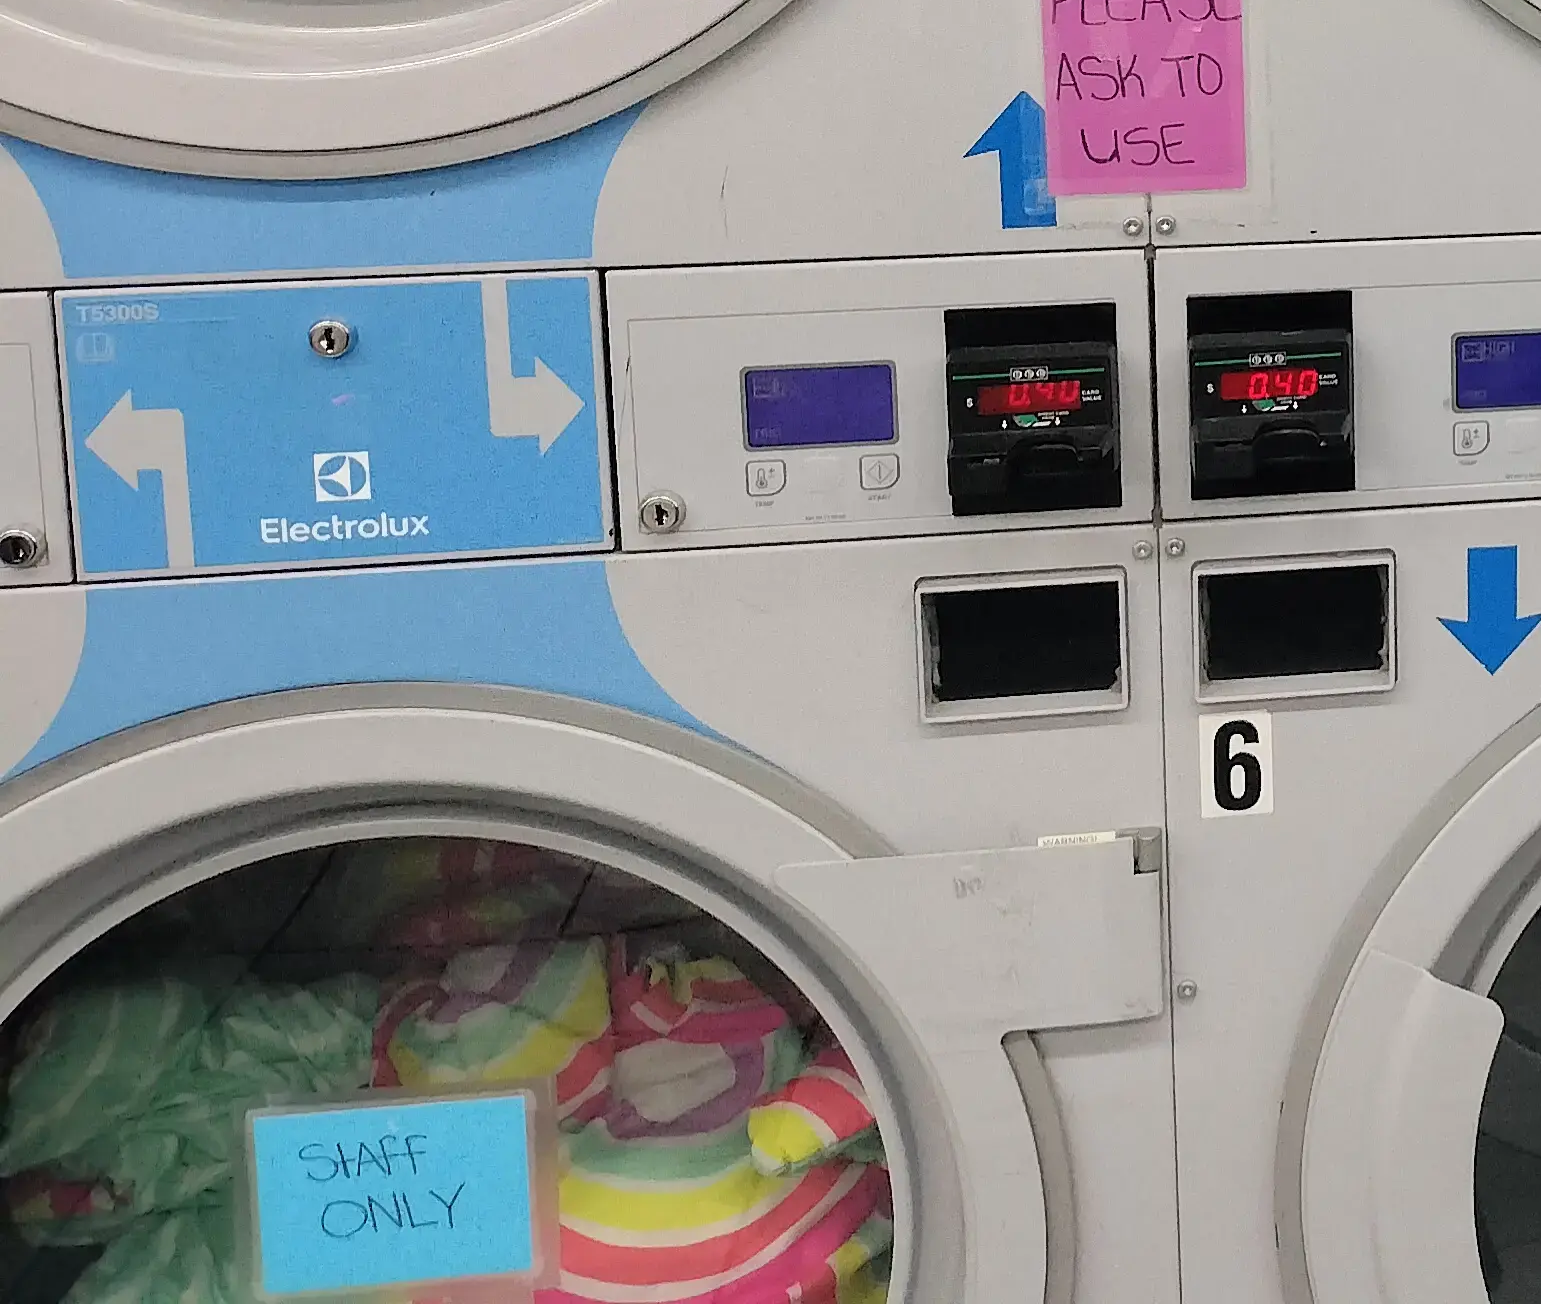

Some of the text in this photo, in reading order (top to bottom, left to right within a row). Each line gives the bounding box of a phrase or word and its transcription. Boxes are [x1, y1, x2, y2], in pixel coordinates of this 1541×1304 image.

[1056, 52, 1223, 101] ASK TO
[1080, 123, 1195, 166] USE
[76, 302, 160, 323] T5300S
[1249, 369, 1318, 399] 0.40
[260, 511, 430, 545] Electrolux
[1213, 719, 1262, 810] 6
[321, 1181, 465, 1238] ONLY
